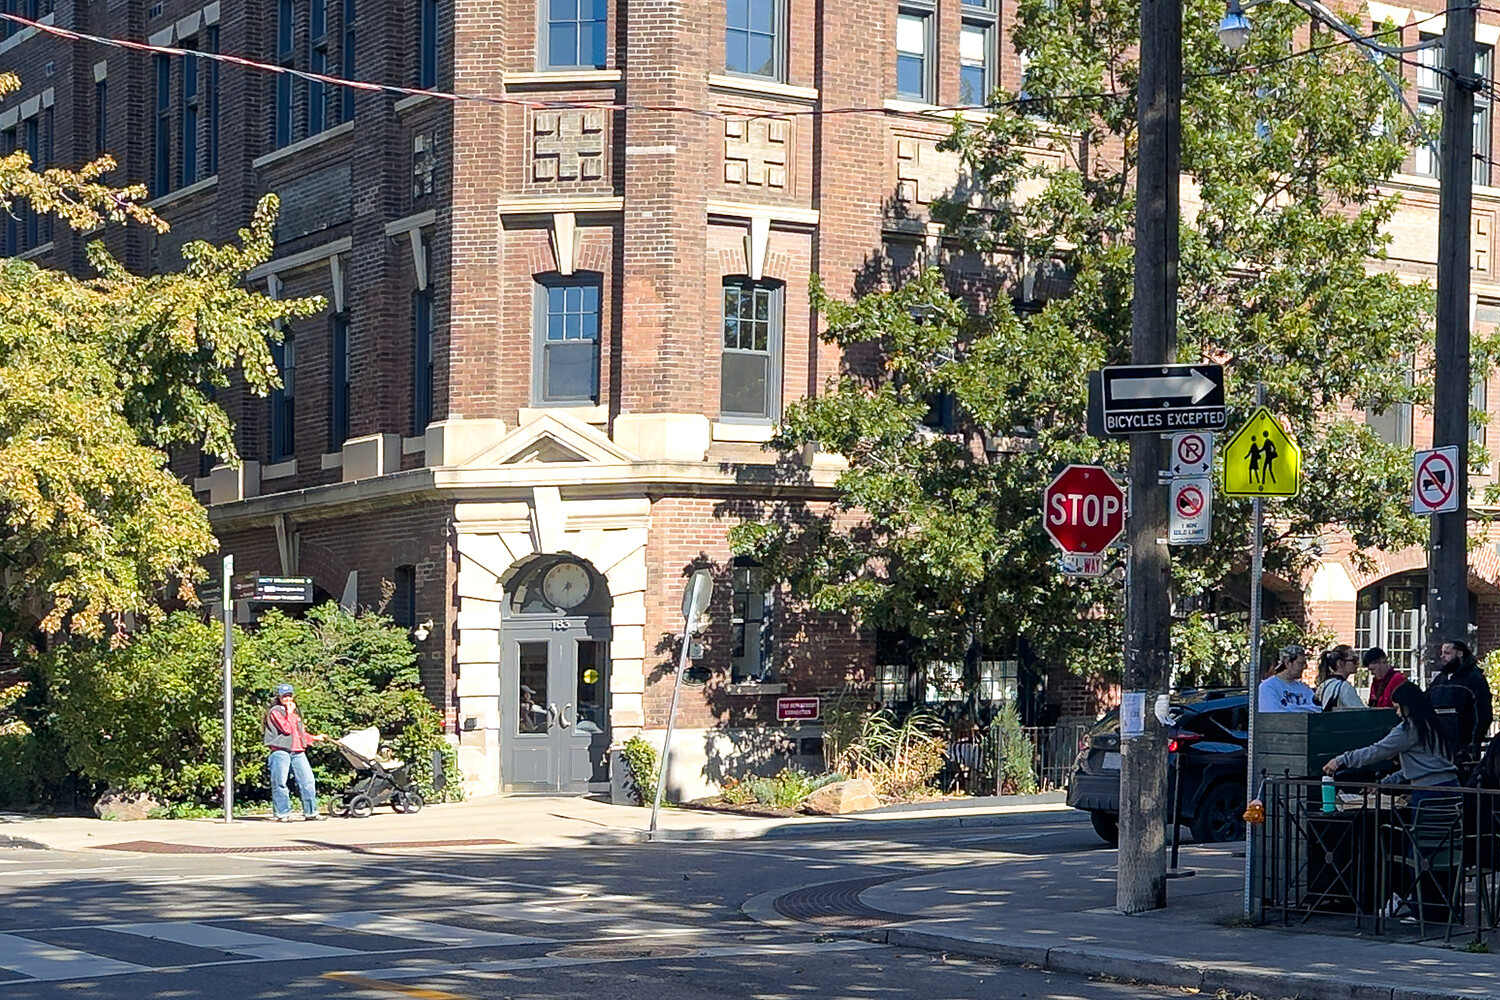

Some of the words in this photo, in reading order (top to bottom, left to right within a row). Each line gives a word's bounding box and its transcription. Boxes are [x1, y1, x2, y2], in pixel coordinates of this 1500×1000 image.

[1107, 414, 1163, 429] BICYCLES
[1167, 411, 1225, 426] EXCEPTED
[1050, 492, 1120, 527] STOP
[1084, 557, 1101, 574] WAY
[552, 619, 571, 630] 183
